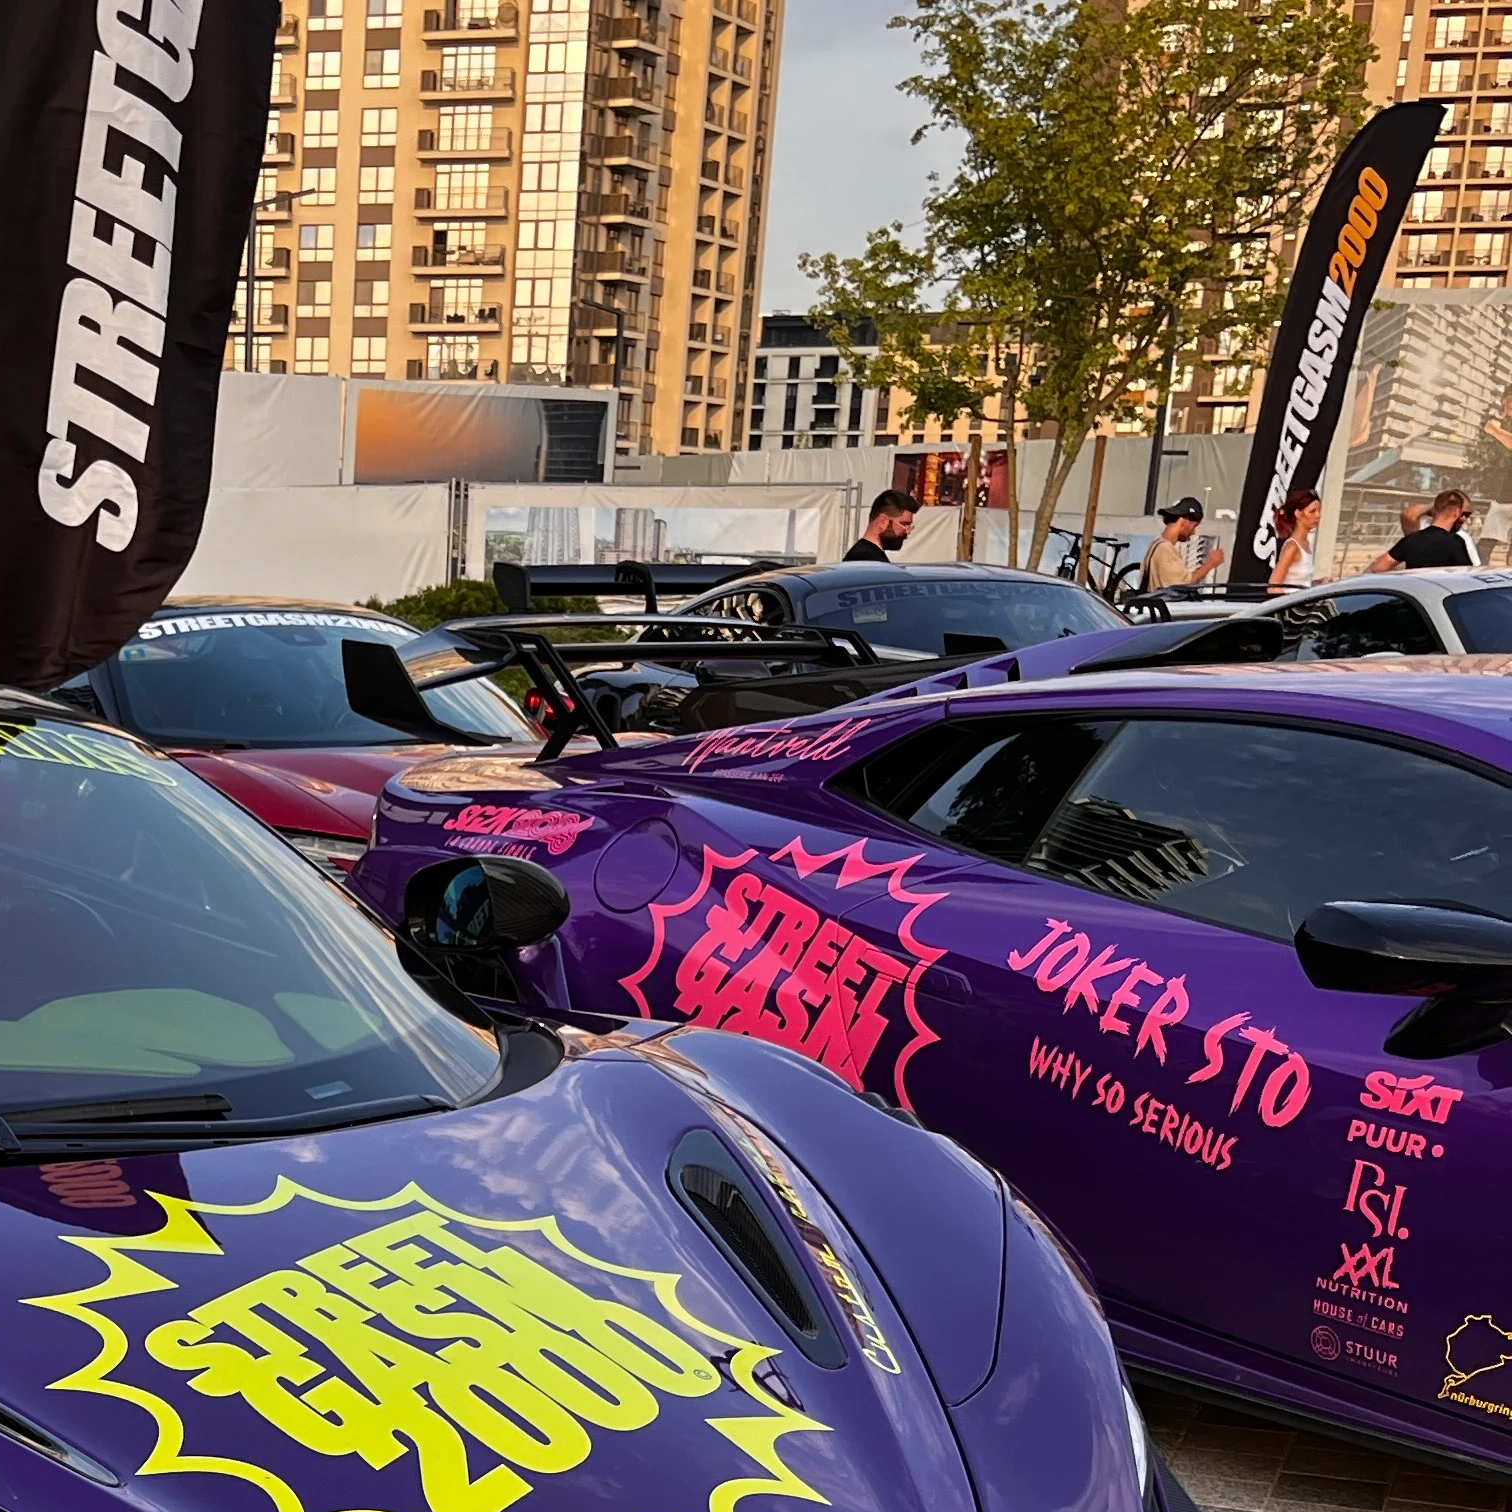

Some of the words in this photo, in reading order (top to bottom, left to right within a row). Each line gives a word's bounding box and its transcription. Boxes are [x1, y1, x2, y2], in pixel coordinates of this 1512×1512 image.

[707, 873, 911, 1018] STREET
[1007, 918, 1190, 1067] JOKER
[1185, 1011, 1312, 1128] STO
[1029, 1035, 1092, 1100] WHY
[1091, 1072, 1125, 1114] SO
[1129, 1092, 1239, 1171] SERIOUS
[144, 1210, 498, 1397] STREET
[1312, 1298, 1354, 1323] HOUSE
[1370, 1316, 1405, 1339] CARS
[1315, 1276, 1409, 1314] NUTRITION
[1332, 1243, 1400, 1289] XXL
[236, 1245, 593, 1458] GASM
[1345, 1340, 1399, 1369] STUUR
